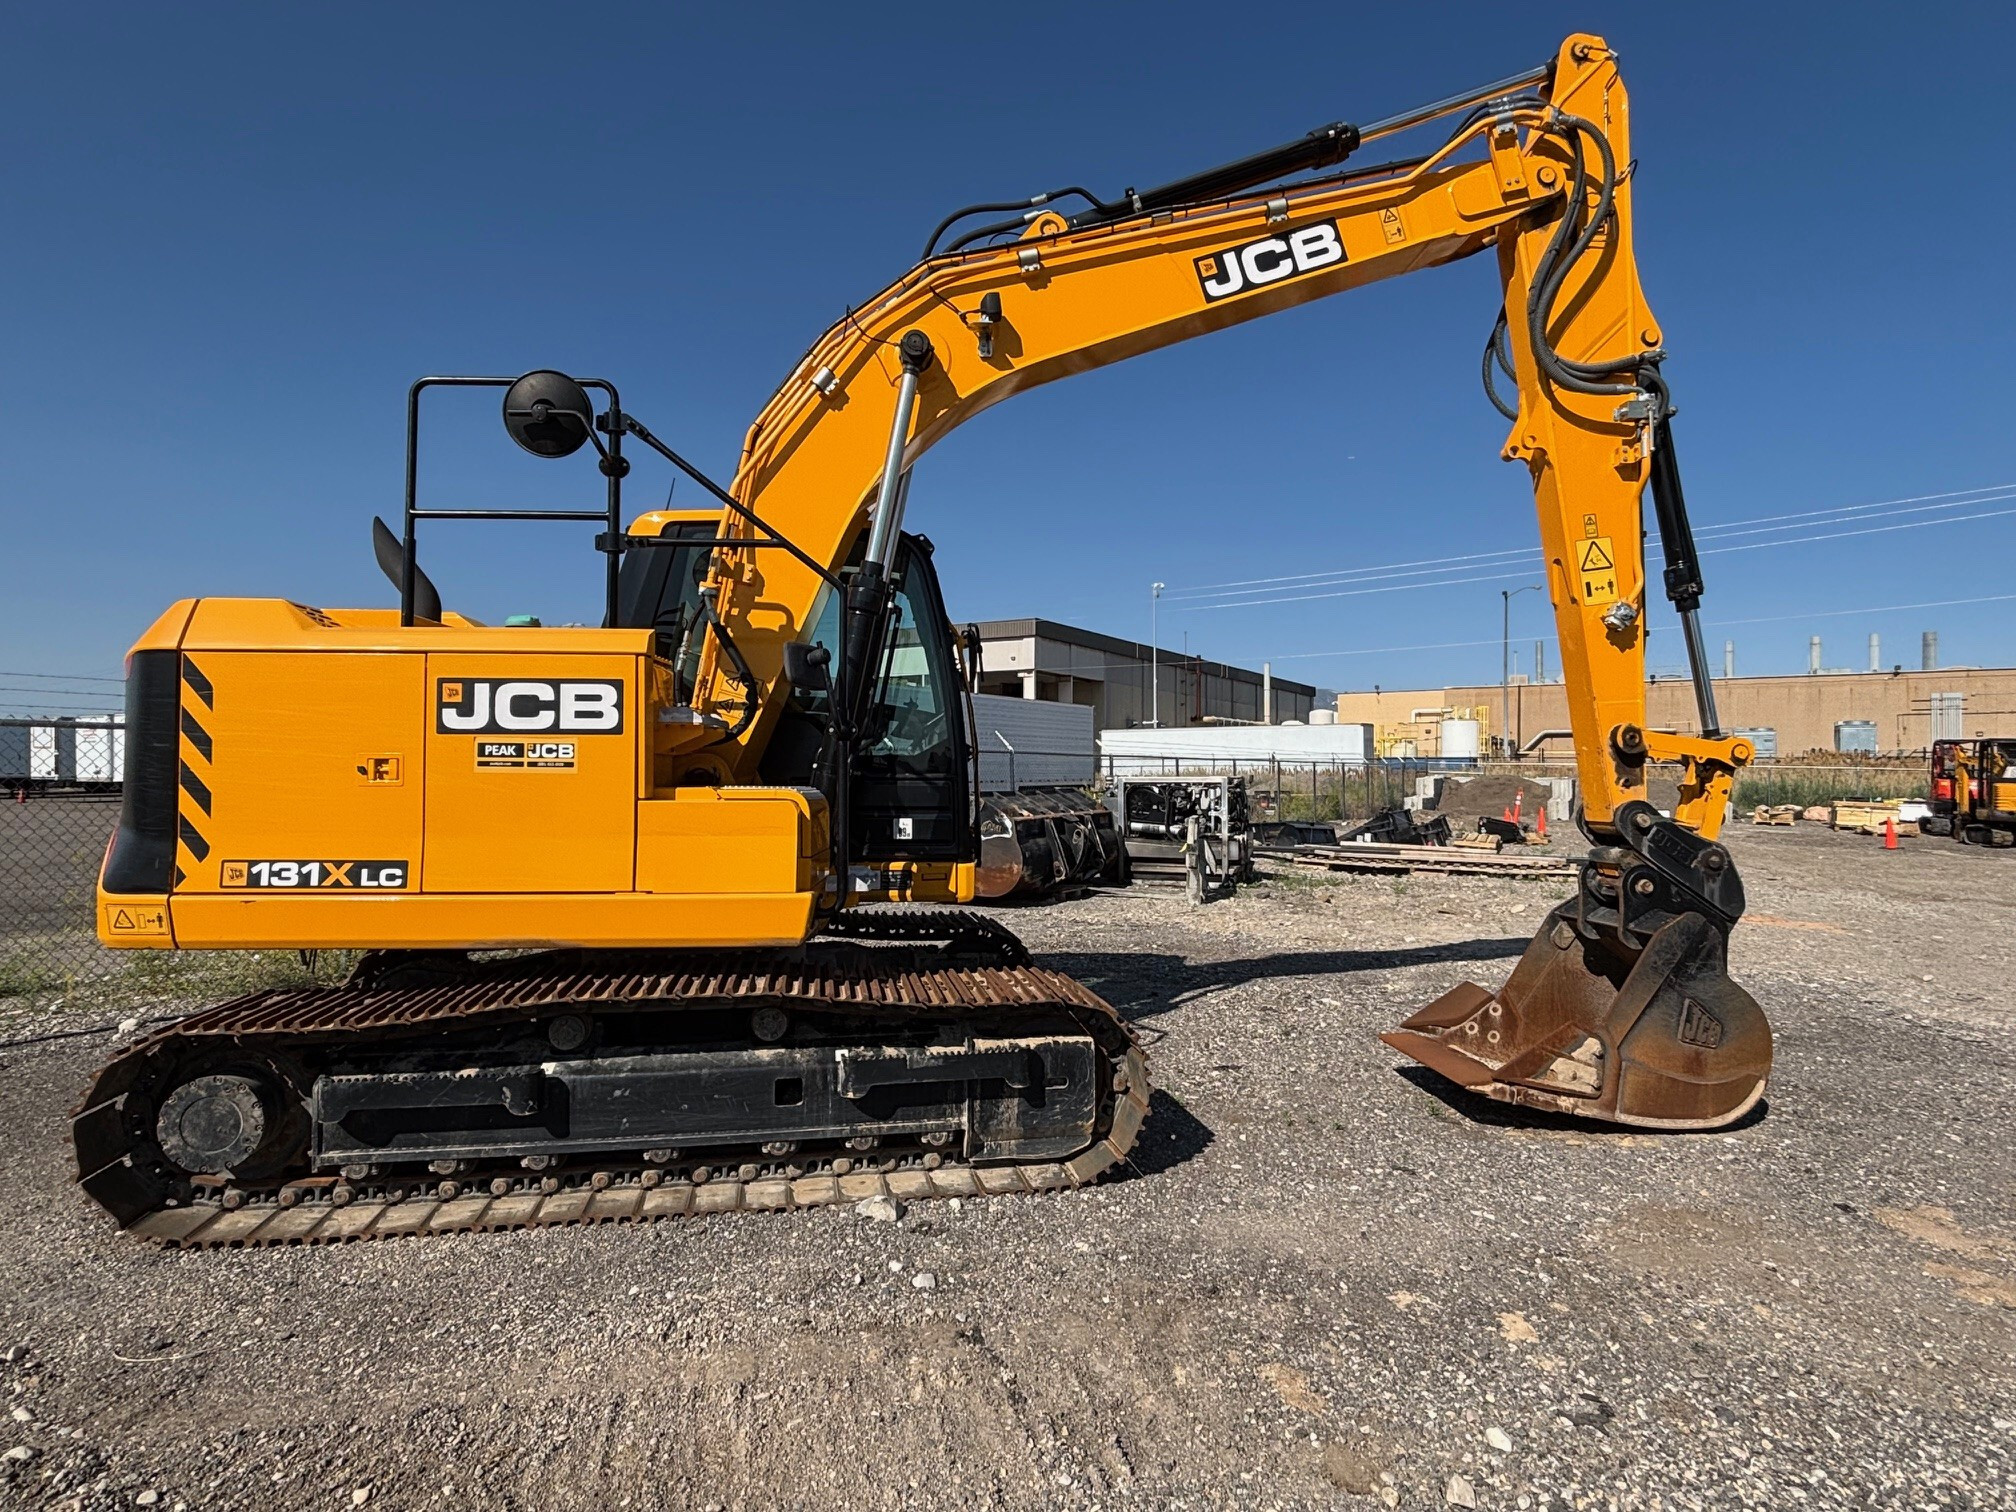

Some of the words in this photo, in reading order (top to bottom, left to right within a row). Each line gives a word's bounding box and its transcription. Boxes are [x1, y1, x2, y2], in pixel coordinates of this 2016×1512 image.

[1204, 224, 1342, 297] JCB
[442, 682, 619, 730] JCB
[484, 744, 517, 756] PEAK
[527, 743, 574, 759] JCB
[250, 862, 355, 887] 131X
[360, 868, 403, 887] LC
[1683, 1002, 1720, 1046] JCB
